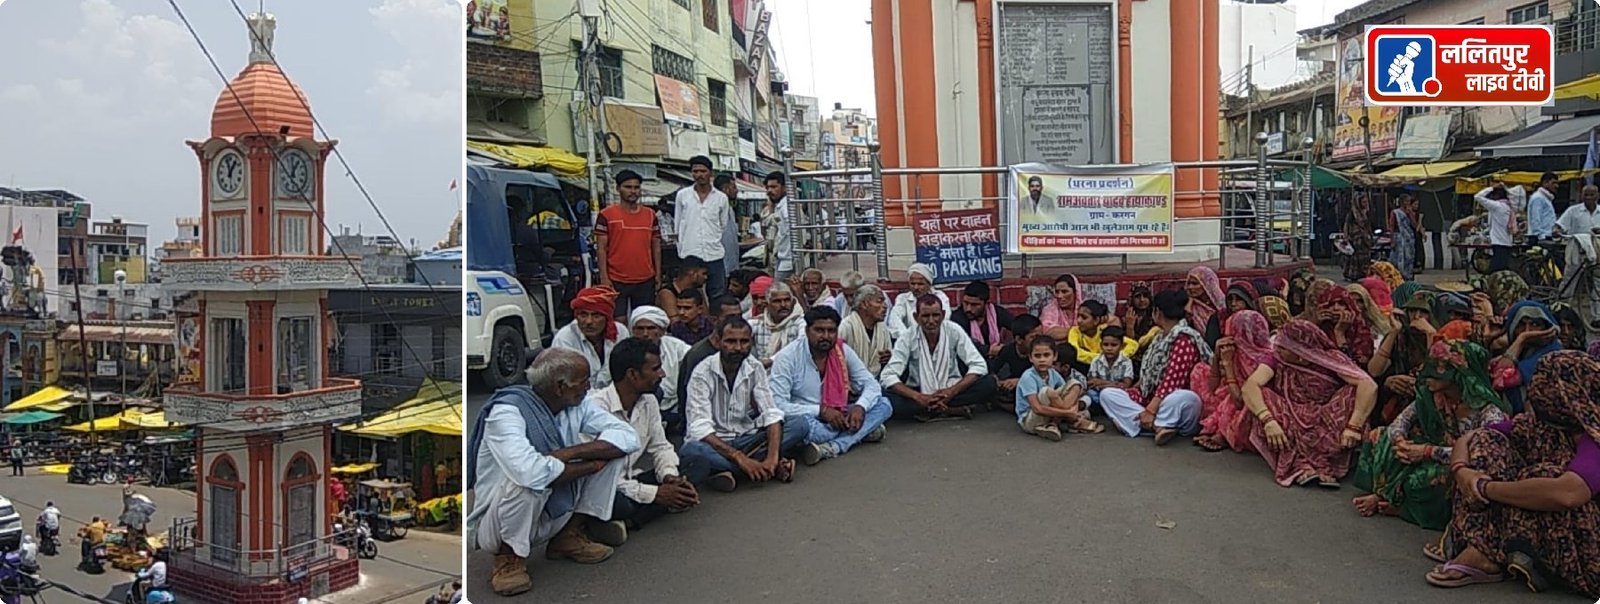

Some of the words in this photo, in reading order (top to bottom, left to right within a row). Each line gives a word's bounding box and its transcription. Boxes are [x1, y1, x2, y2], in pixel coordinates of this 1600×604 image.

[919, 214, 940, 232] यहाँ
[943, 217, 960, 229] पर
[961, 214, 992, 228] वाहन
[942, 257, 1002, 277] PARKING
